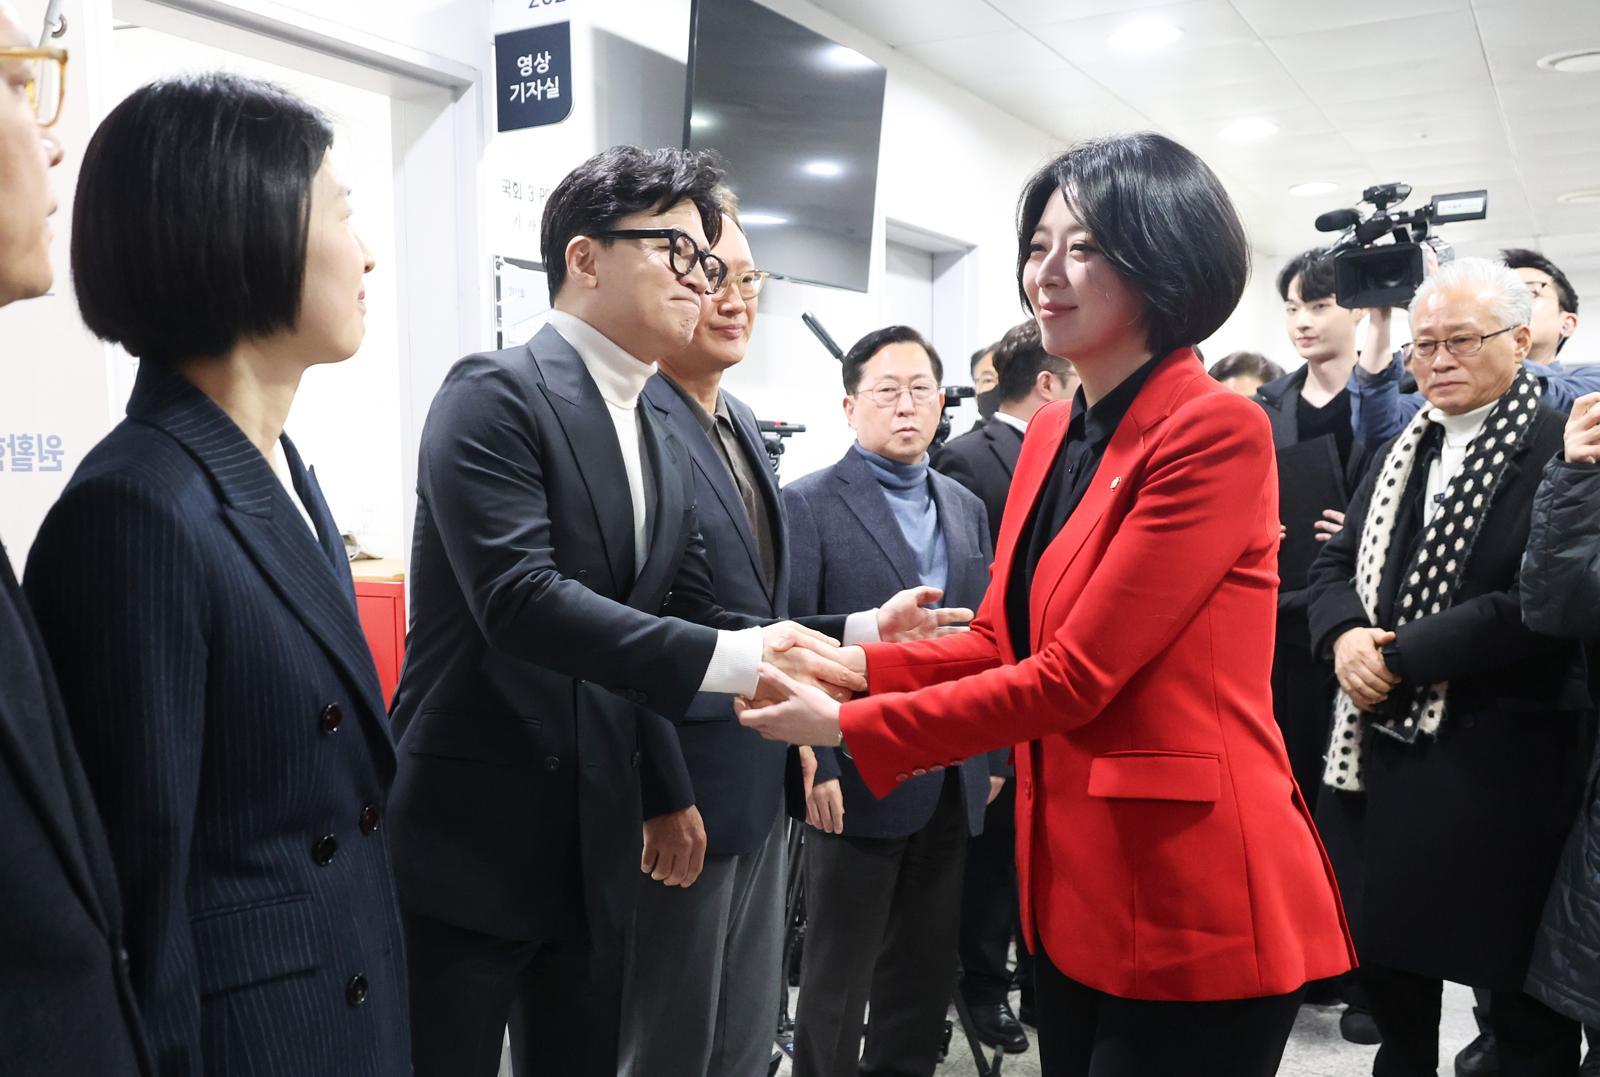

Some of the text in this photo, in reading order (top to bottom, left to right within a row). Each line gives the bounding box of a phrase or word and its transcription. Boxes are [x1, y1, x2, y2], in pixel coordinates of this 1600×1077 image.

[517, 51, 552, 77] 영상
[509, 75, 560, 104] 기자실
[502, 179, 522, 200] 국회
[528, 184, 534, 202] 3
